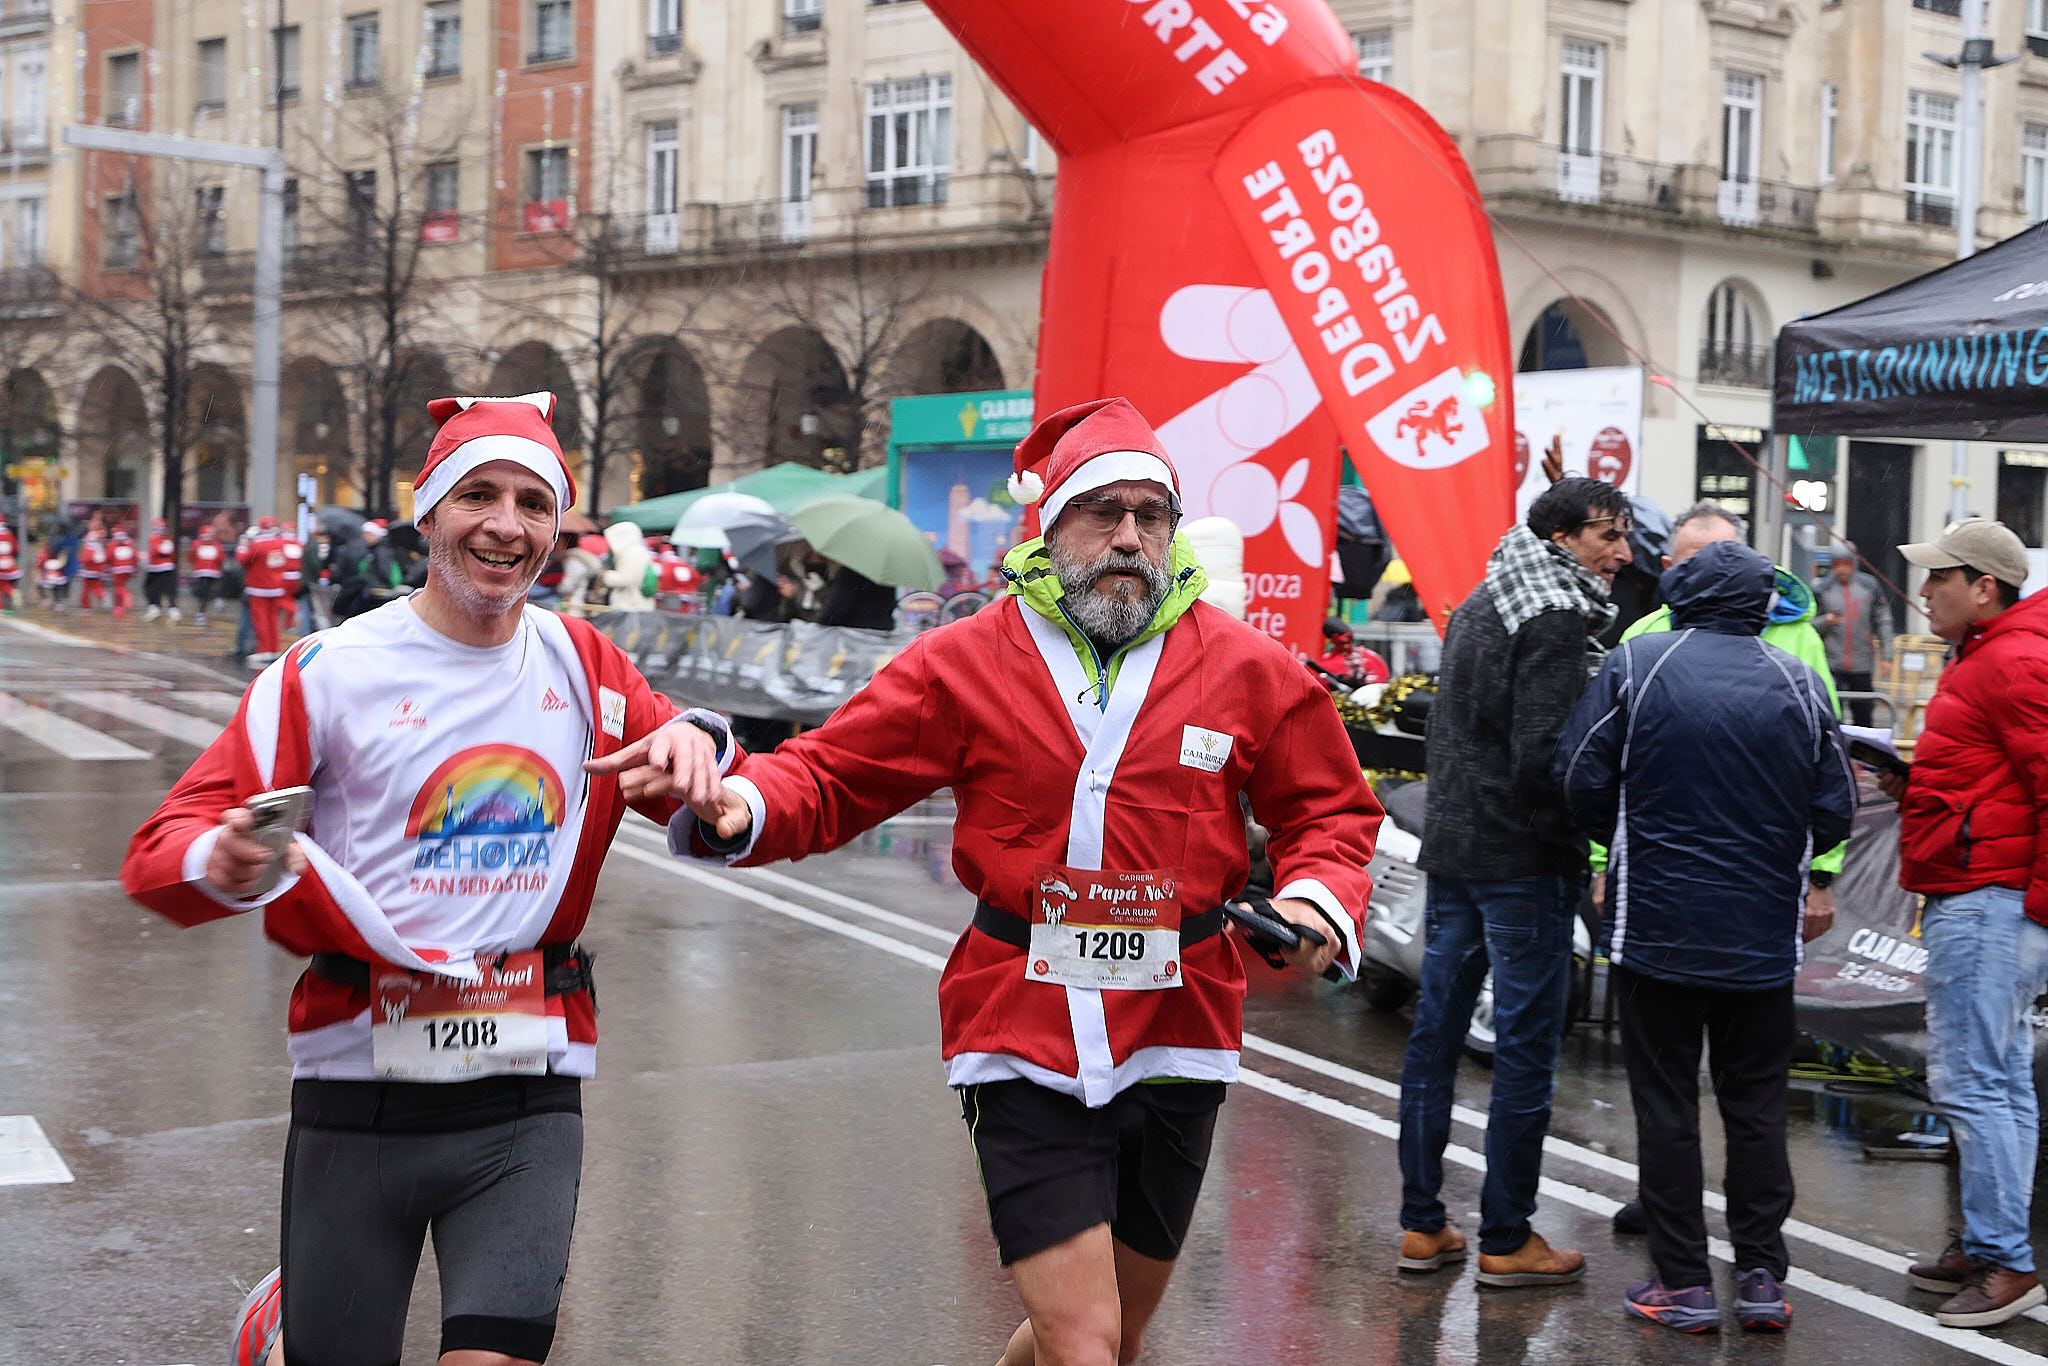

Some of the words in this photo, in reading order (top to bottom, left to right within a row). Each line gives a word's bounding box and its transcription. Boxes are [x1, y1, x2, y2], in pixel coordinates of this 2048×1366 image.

[1792, 327, 2048, 404] METARUNNING
[1183, 748, 1203, 760] CAJA
[1119, 873, 1154, 882] CARRERA
[1088, 883, 1137, 904] Papá
[1109, 907, 1131, 916] CAJA
[1132, 908, 1157, 917] RURAL
[1075, 931, 1145, 961] 1209
[423, 1019, 498, 1051] 1208
